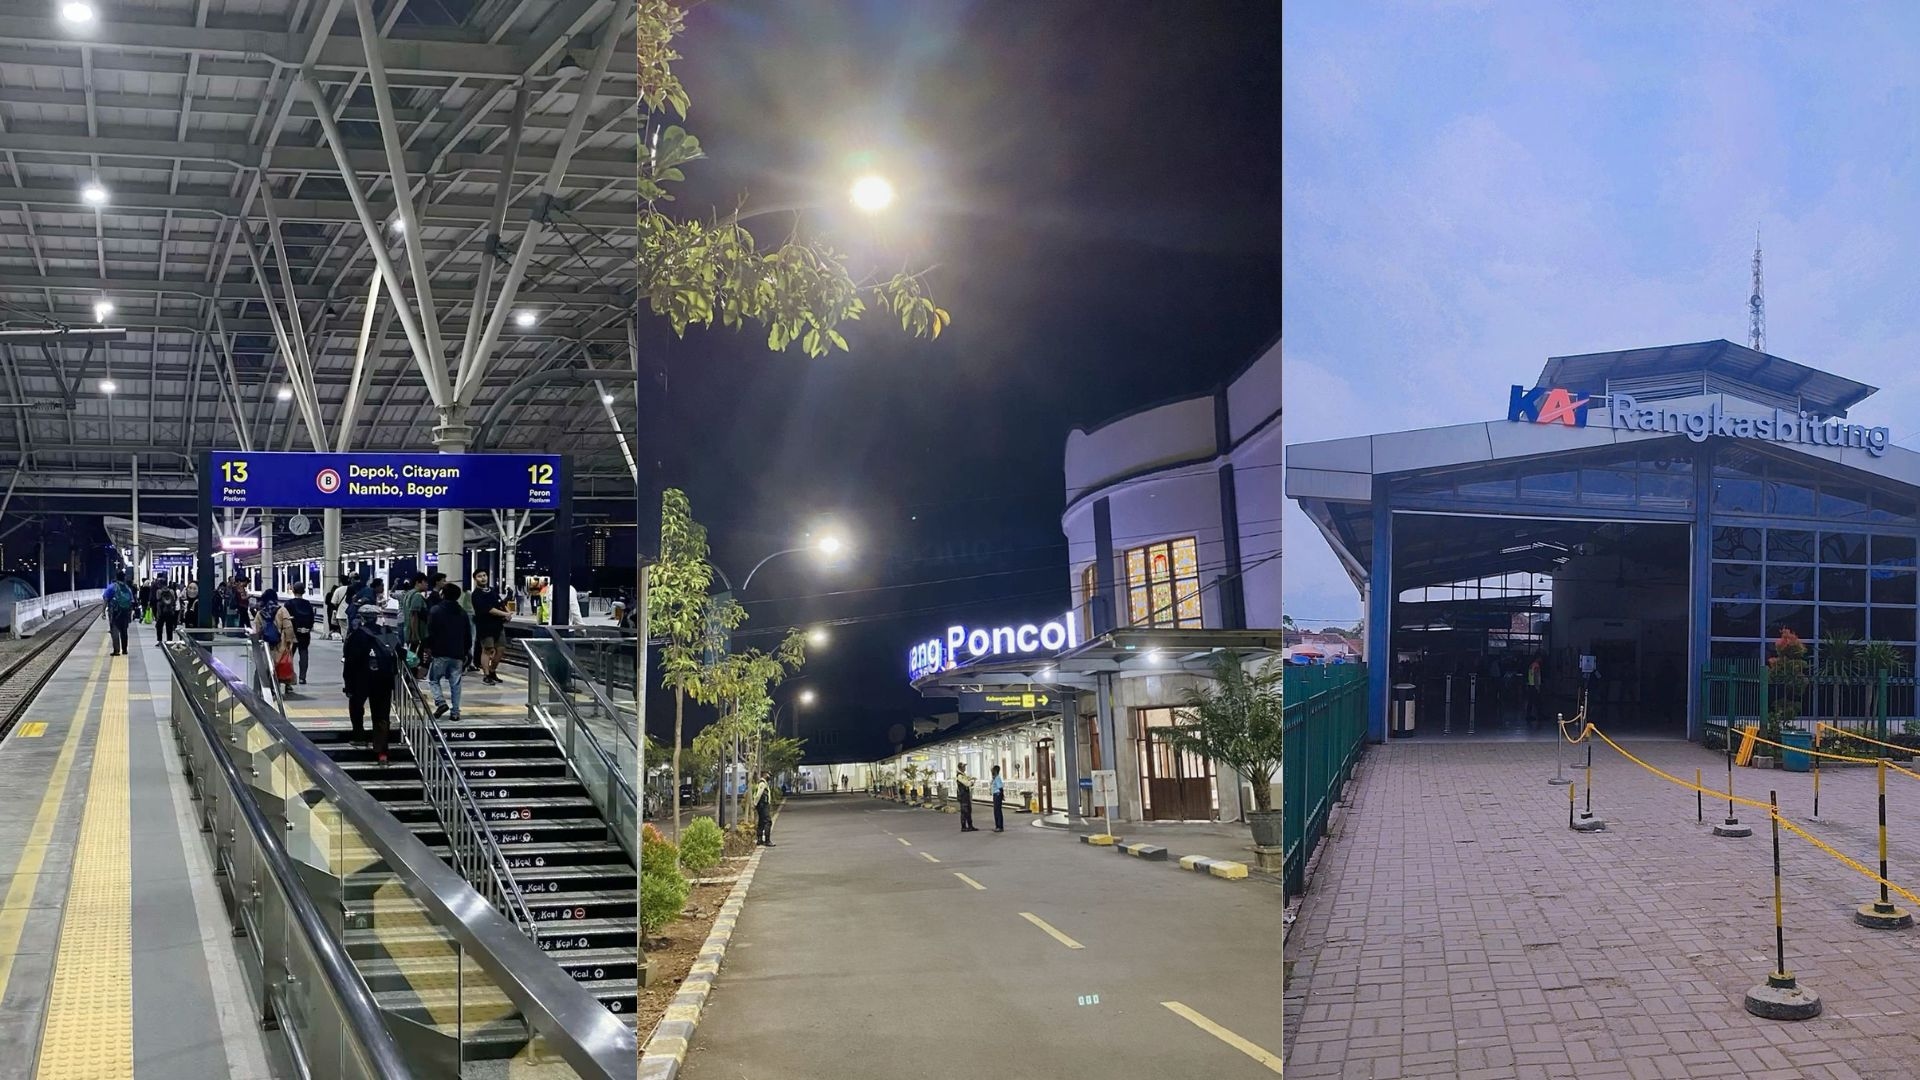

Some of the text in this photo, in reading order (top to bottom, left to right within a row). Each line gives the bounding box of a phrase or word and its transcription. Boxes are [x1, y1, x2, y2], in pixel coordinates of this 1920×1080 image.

[1508, 384, 1890, 458] KAI Rangkasbitung
[221, 461, 248, 483] 13
[349, 465, 460, 481] Depok, Citayam
[527, 464, 553, 485] 12
[325, 476, 332, 485] B
[223, 487, 246, 495] Peron
[349, 482, 448, 498] Nambo, Bogor
[529, 489, 551, 497] Peron
[947, 611, 1078, 661] Poncol
[541, 911, 558, 919] Kcal
[555, 939, 573, 948] Kcal
[571, 970, 589, 978] Kcal
